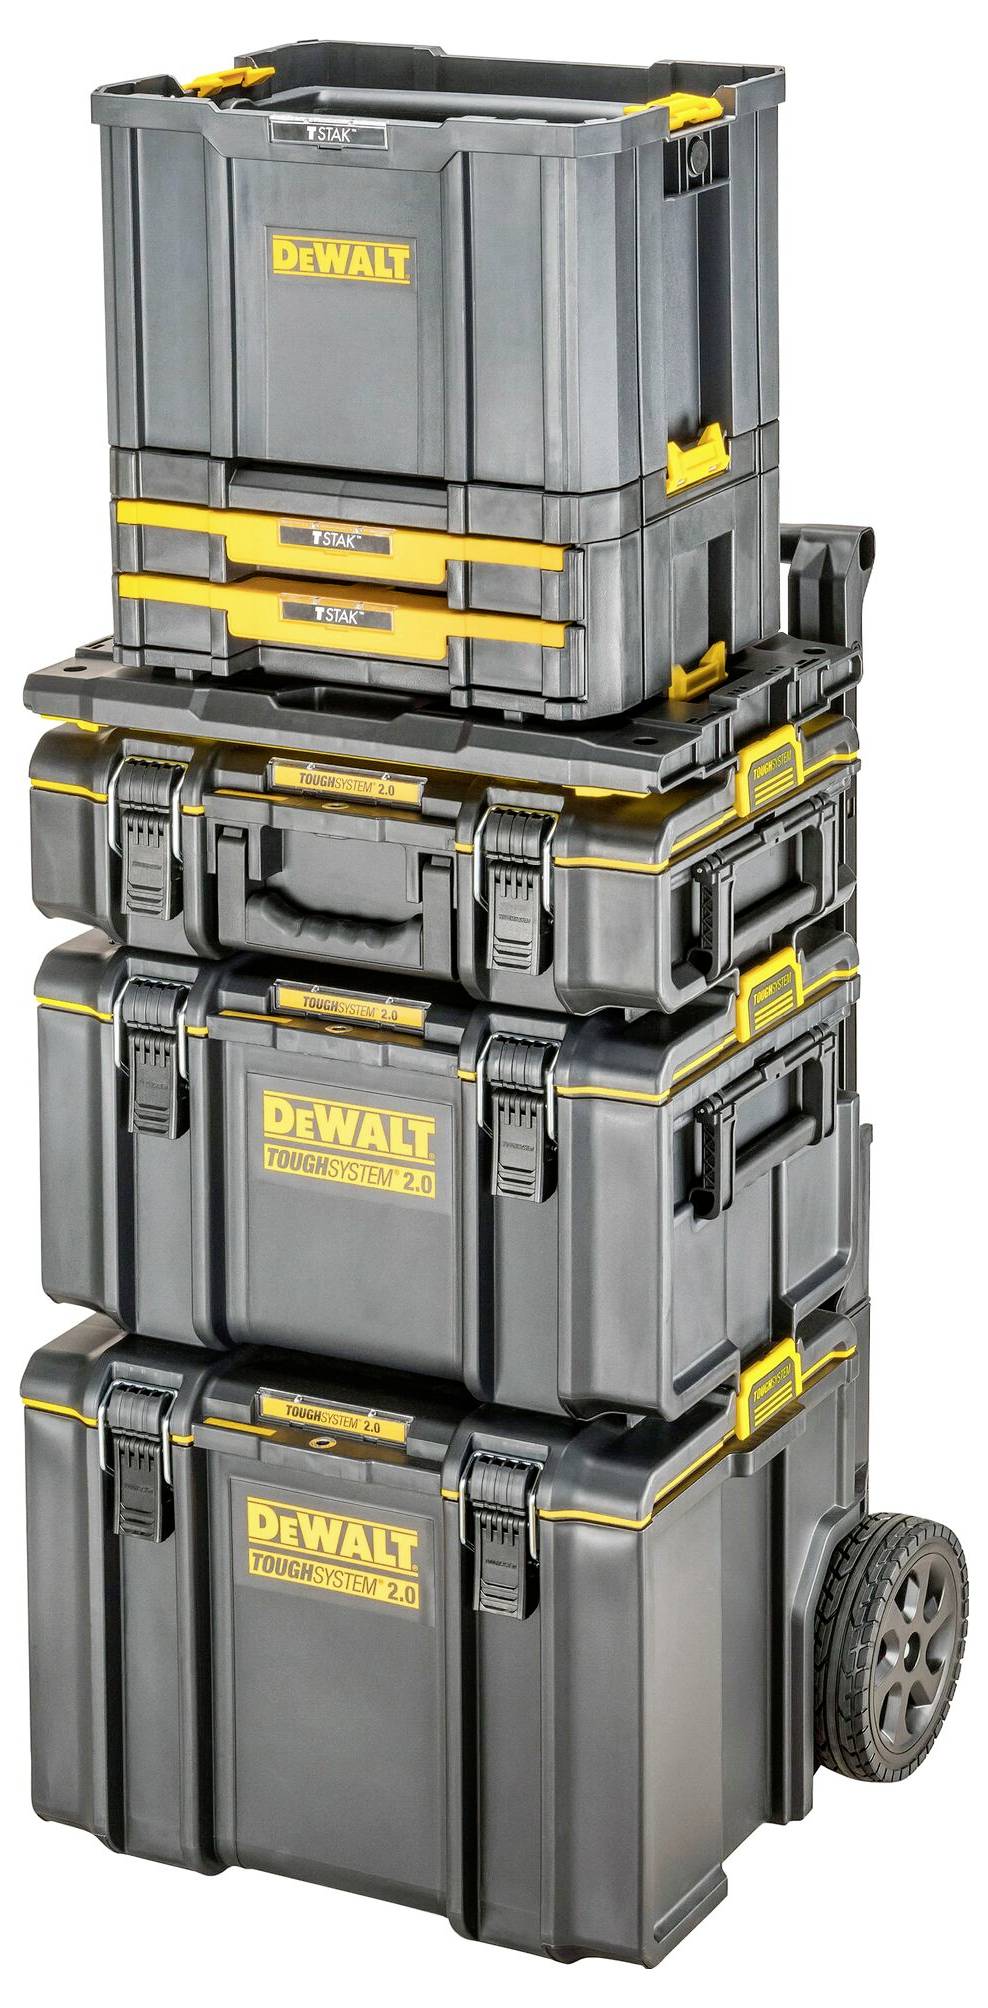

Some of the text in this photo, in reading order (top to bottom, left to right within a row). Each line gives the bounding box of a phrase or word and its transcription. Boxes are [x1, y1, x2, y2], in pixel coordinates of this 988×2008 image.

[378, 783, 395, 796] 2.0
[380, 1009, 398, 1021] 2.0
[403, 1171, 433, 1194] 2.0
[363, 1420, 381, 1433] 2.0
[387, 1581, 417, 1605] 2.0
